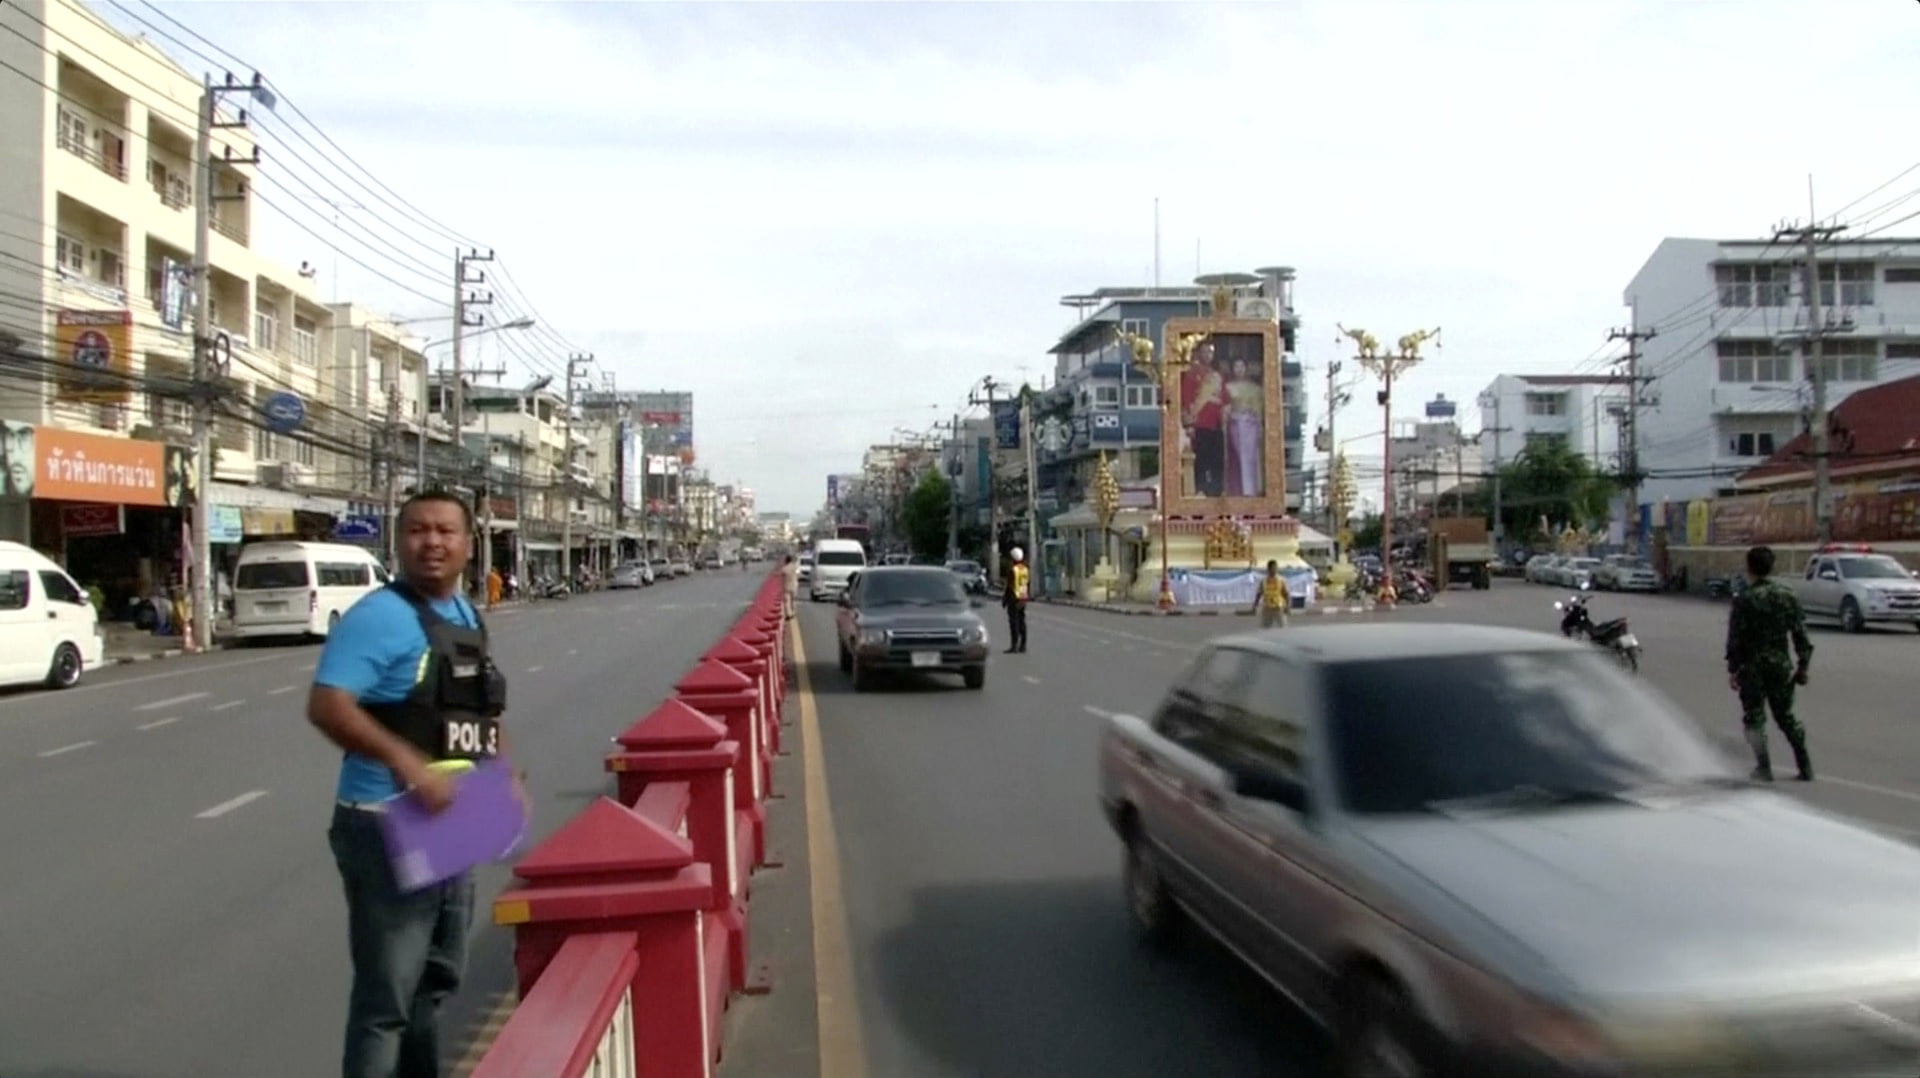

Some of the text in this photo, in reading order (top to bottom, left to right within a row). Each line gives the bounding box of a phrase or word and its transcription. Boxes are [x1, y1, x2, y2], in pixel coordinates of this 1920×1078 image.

[48, 447, 155, 488] หัวหินการแว่น
[448, 721, 497, 755] POL
